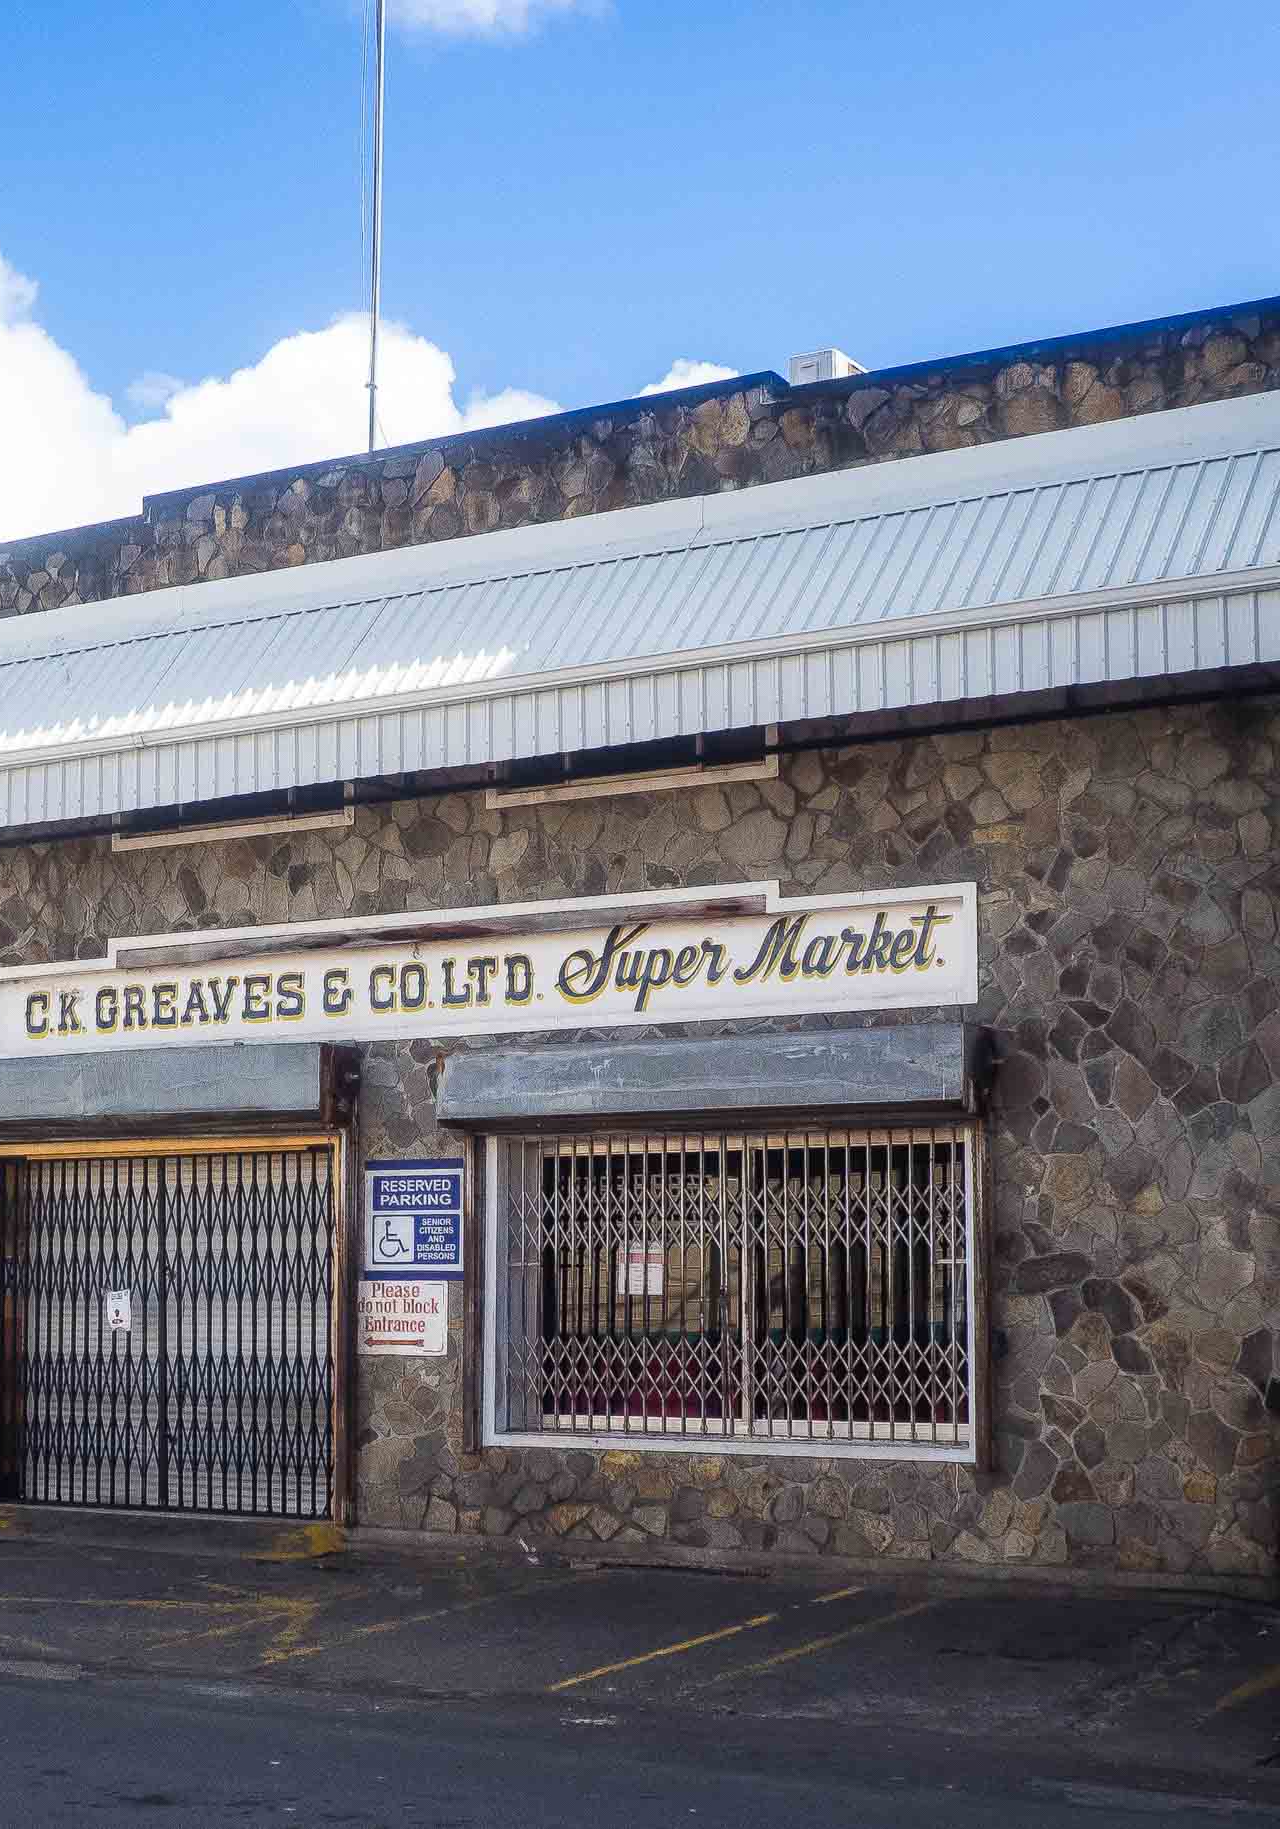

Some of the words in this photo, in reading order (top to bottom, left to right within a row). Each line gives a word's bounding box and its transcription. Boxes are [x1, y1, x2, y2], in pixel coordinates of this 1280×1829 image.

[95, 970, 307, 1032] GREAVES
[322, 963, 356, 1016] &
[368, 959, 436, 1014] CO.
[440, 952, 545, 1009] LTD.
[554, 922, 732, 1013] Super
[380, 1179, 452, 1193] RESERVED
[380, 1193, 452, 1206] PARKING
[422, 1217, 452, 1226] SENIOR
[419, 1226, 454, 1234] CITIZENS
[427, 1235, 445, 1243] AND
[416, 1243, 456, 1252] DISABLED
[417, 1252, 456, 1261] PERSONS
[371, 1282, 421, 1298] Please
[357, 1297, 373, 1314] do
[375, 1298, 398, 1314] not
[402, 1297, 439, 1314] block
[363, 1315, 426, 1333] Entrance
